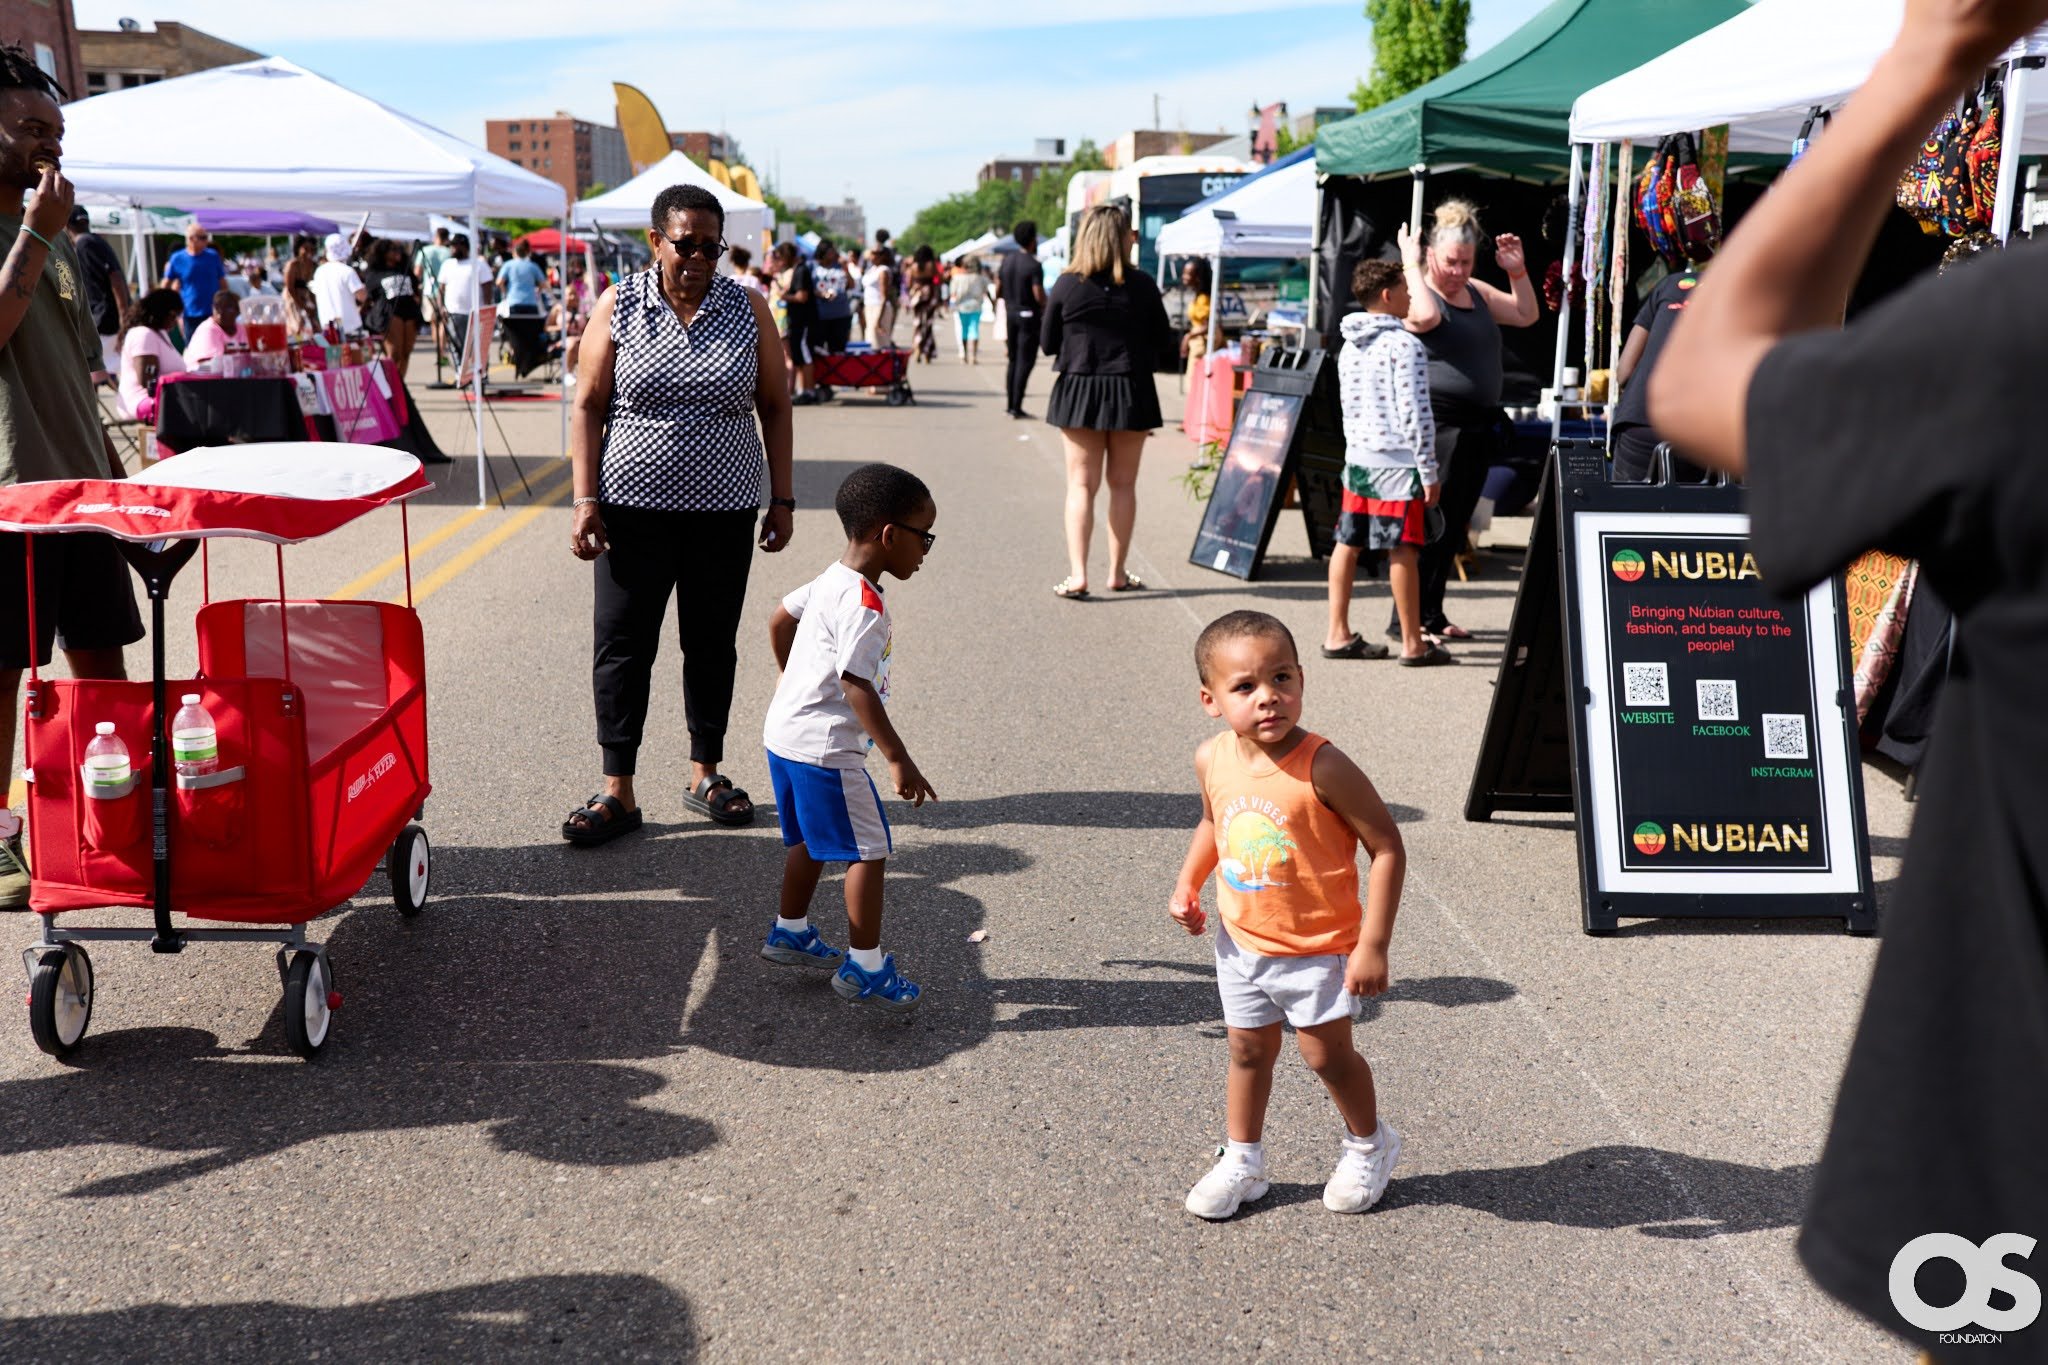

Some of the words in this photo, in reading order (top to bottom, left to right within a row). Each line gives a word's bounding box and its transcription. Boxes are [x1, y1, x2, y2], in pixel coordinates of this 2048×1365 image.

[1202, 176, 1241, 197] CAT
[1652, 551, 1764, 580] NUBIA
[1631, 605, 1685, 621] Bringing
[1688, 606, 1735, 619] Nubian
[1738, 607, 1784, 621] culture,
[1626, 622, 1678, 636] fashion,
[1681, 623, 1706, 635] and
[1709, 623, 1752, 638] beauty
[1756, 625, 1769, 636] to
[1771, 624, 1792, 636] the
[1687, 639, 1735, 653] people!
[1620, 711, 1675, 724] WEBSITE
[1692, 725, 1751, 737] FACEBOOK
[1751, 767, 1814, 778] INSTAGRAM
[1251, 796, 1288, 826] VIBES
[1672, 823, 1809, 853] NUBIAN
